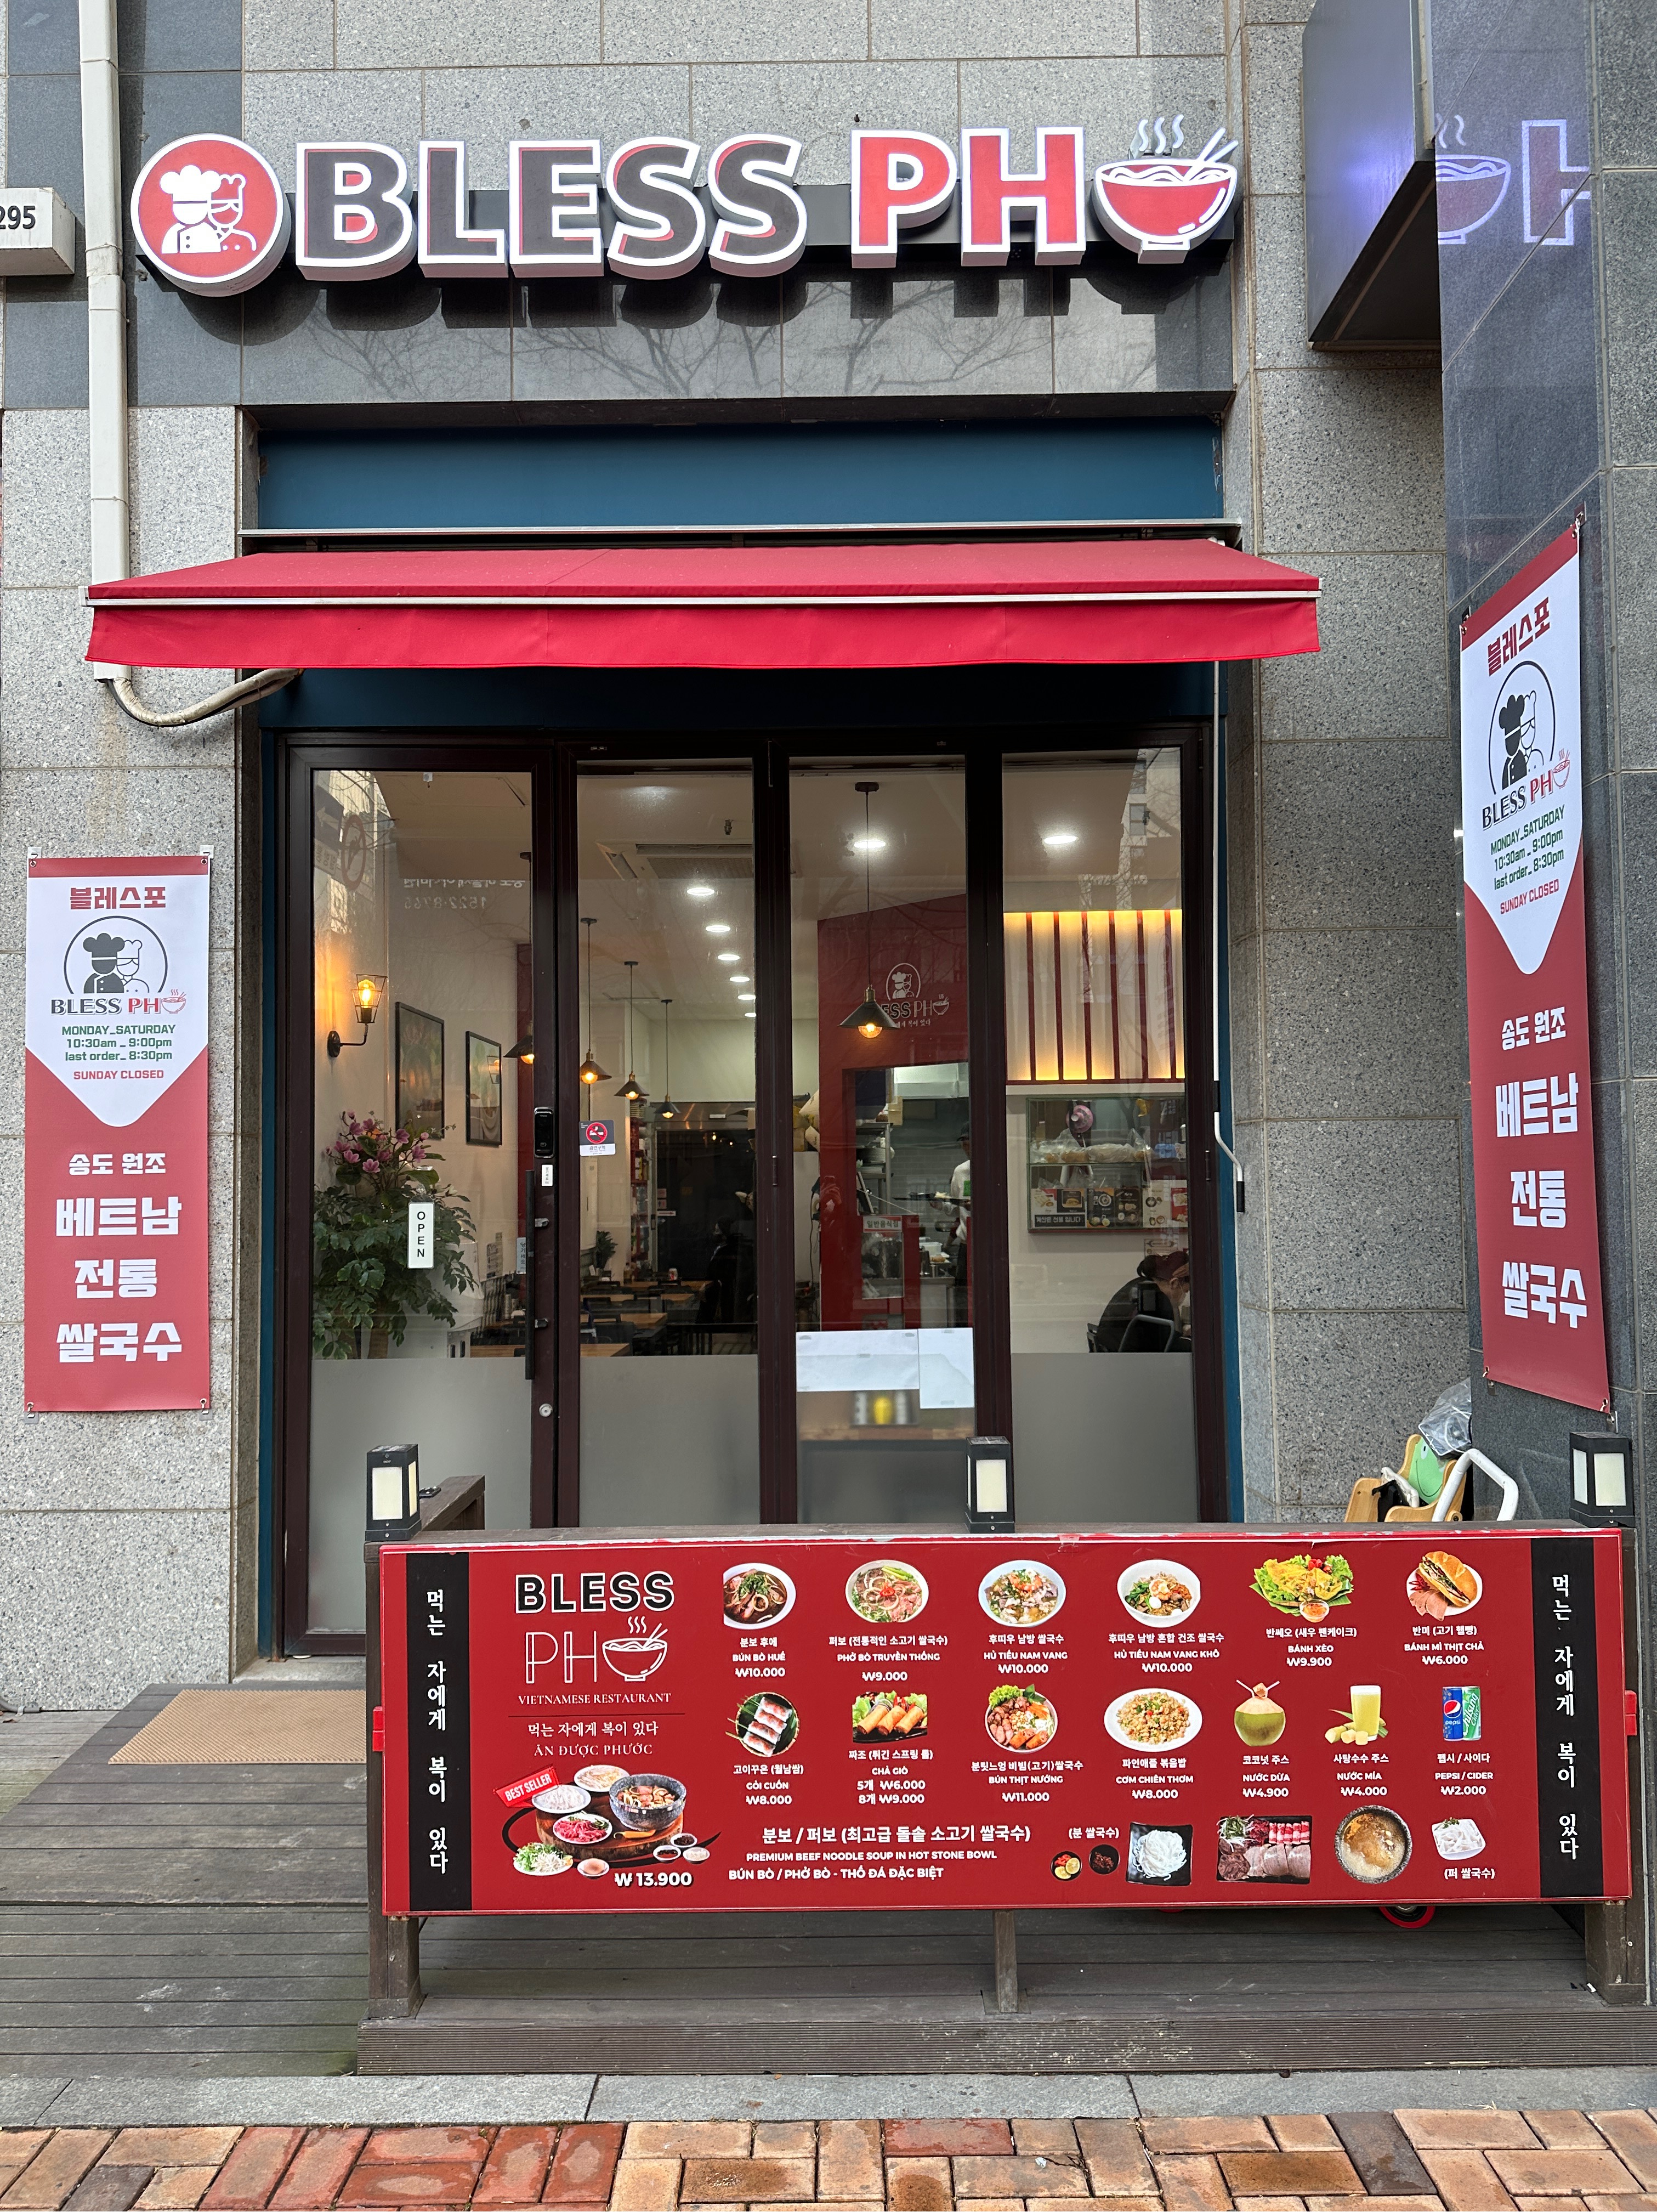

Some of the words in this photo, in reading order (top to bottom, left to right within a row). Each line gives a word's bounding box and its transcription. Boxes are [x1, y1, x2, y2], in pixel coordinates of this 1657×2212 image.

[296, 133, 808, 280] BLESS
[1488, 597, 1550, 676] 블레스포
[1483, 785, 1525, 830] BLESS
[1495, 848, 1525, 872] 10:30am
[1533, 829, 1563, 853] 9:00pm
[1494, 874, 1507, 891] last
[1534, 848, 1564, 872] 8:30pm
[70, 887, 166, 909] 블레스포
[1500, 892, 1528, 914] SUNDAY
[1529, 879, 1559, 902] CLOSED
[51, 998, 123, 1016] BLESS
[881, 1002, 911, 1019] ESS
[1502, 1016, 1529, 1050] 송도
[1534, 1006, 1566, 1044] 원조
[67, 1039, 117, 1048] 10:30am
[129, 1038, 172, 1049] 9:00pm
[65, 1052, 87, 1061] last
[129, 1051, 172, 1061] 8:30pm
[73, 1071, 118, 1080] SUNDAY
[121, 1070, 164, 1079] CLOSED
[1496, 1072, 1579, 1138] 베트남
[69, 1153, 113, 1175] 송도
[122, 1153, 166, 1174] 원조
[1511, 1170, 1567, 1228] 전통
[56, 1197, 182, 1237] 베트남
[75, 1259, 157, 1299] 전통
[1502, 1261, 1587, 1328] 쌀국수
[56, 1322, 182, 1363] 쌀국수
[515, 1571, 674, 1614] BLESS
[1552, 1574, 1572, 1621] 먹는
[427, 1589, 446, 1636] 먹는
[989, 1634, 1015, 1644] 후띠우
[1018, 1634, 1035, 1644] 남방
[1037, 1634, 1064, 1644] 쌀국수
[1109, 1633, 1135, 1643] 후띠우
[1138, 1633, 1155, 1643] 남방
[1157, 1633, 1175, 1643] 혼합
[1178, 1633, 1195, 1643] 건조
[1198, 1633, 1224, 1643] 쌀국수
[1295, 1627, 1316, 1638] (새우
[1412, 1626, 1429, 1636] 반미
[1433, 1626, 1453, 1636] (고기
[740, 1637, 758, 1648] 분보
[760, 1637, 778, 1648] 후에
[829, 1636, 847, 1647] 퍼보
[849, 1636, 887, 1647] (전통적인
[890, 1636, 916, 1645] 소고기
[918, 1635, 947, 1646] 쌀국수)
[1554, 1645, 1574, 1717] 자에게
[427, 1660, 446, 1731] 자에게
[518, 1694, 591, 1705] VIETNAMESE
[594, 1693, 671, 1704] RESTAURANT
[528, 1723, 554, 1738] 먹는
[558, 1722, 597, 1737] 자에게
[601, 1722, 627, 1736] 복이
[633, 1721, 659, 1736] 있다
[559, 1744, 598, 1758] ĐƯỢC
[892, 1750, 918, 1760] 스프링
[1242, 1755, 1269, 1765] 코코넛
[1272, 1755, 1290, 1765] 주스
[1333, 1754, 1369, 1764] 사탕수수
[1371, 1754, 1389, 1763] 주스
[1463, 1753, 1490, 1763] 사이다
[1122, 1758, 1157, 1769] 파인애플
[1160, 1758, 1187, 1768] 볶음밥
[1557, 1743, 1576, 1789] 복이
[428, 1756, 447, 1803] 복이
[504, 1784, 525, 1802] BEST
[524, 1773, 552, 1793] SELLER
[857, 1779, 873, 1791] 5개
[859, 1794, 876, 1804] 8개
[763, 1828, 792, 1844] 분보
[807, 1827, 837, 1844] 퍼보
[841, 1826, 892, 1843] (최고급
[896, 1826, 926, 1843] 돌솥
[931, 1825, 975, 1842] 소고기
[980, 1825, 1030, 1842] 쌀국수)
[1069, 1828, 1083, 1840] (분
[1085, 1827, 1120, 1839] 쌀국수)
[1559, 1814, 1579, 1860] 있다
[429, 1827, 449, 1874] 있다
[746, 1853, 793, 1861] PREMIUM
[796, 1852, 821, 1860] BEEF
[823, 1852, 864, 1860] NOODLE
[866, 1852, 894, 1860] SOUP
[908, 1851, 929, 1859] HOT
[931, 1851, 964, 1859] STONE
[967, 1851, 997, 1859] BOWL
[636, 1872, 692, 1886] 13.900
[729, 1868, 754, 1880] BÚN
[757, 1867, 775, 1880] BÒ
[813, 1867, 831, 1879] BÒ
[888, 1866, 915, 1881] ĐẶC
[917, 1865, 944, 1880] BIỆT
[1444, 1868, 1458, 1880] (퍼
[1461, 1868, 1495, 1879] 쌀국수)
